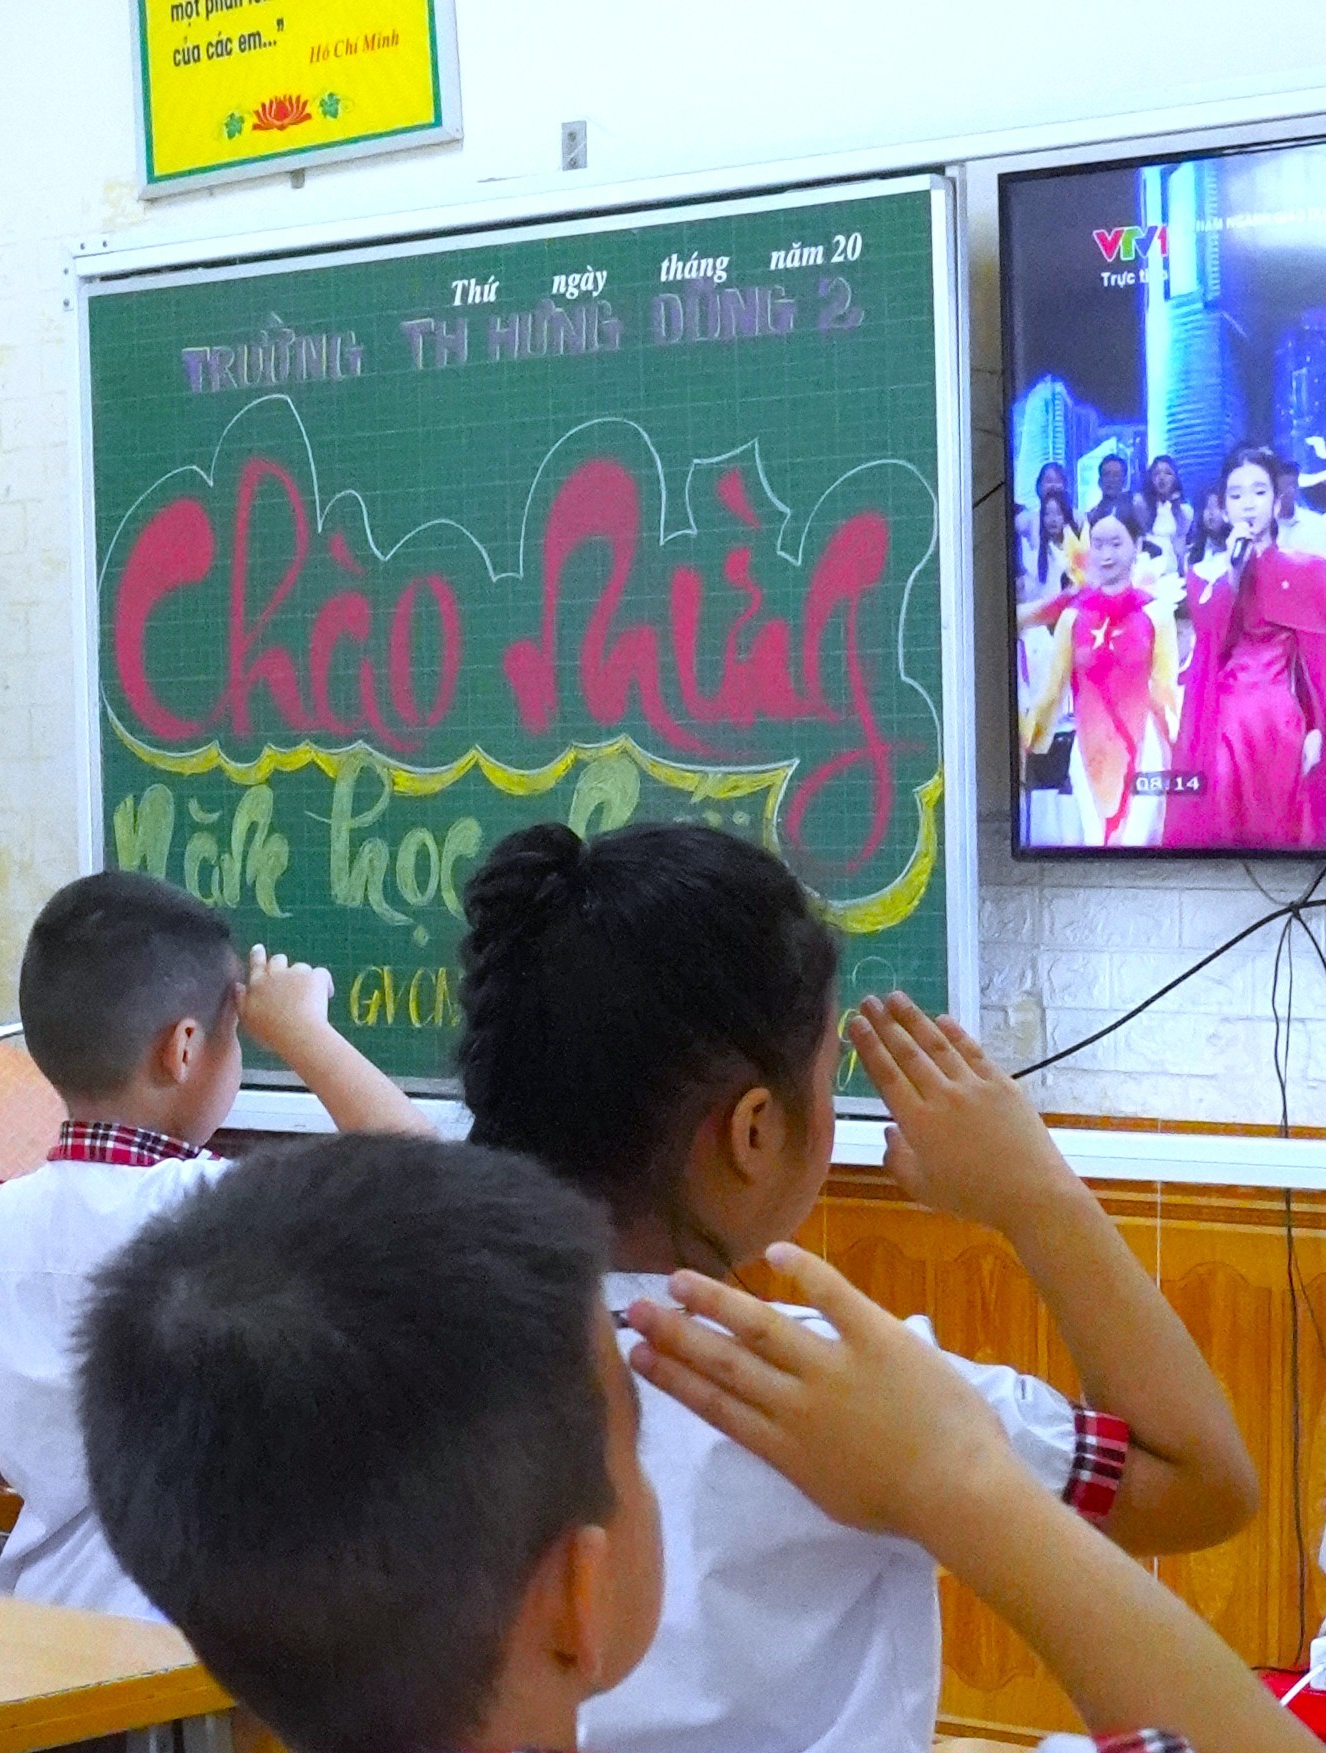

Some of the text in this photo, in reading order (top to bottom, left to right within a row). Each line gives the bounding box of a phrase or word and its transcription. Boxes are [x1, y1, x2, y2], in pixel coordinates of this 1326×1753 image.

[172, 36, 201, 67] của
[205, 31, 234, 61] các
[332, 36, 358, 59] Chí
[362, 29, 400, 52] Minh
[451, 231, 863, 307] Thứ ngày tháng năm 20
[1092, 225, 1169, 263] VTV1
[400, 317, 469, 371] TH
[817, 275, 866, 331] 2
[114, 455, 464, 753] Chào
